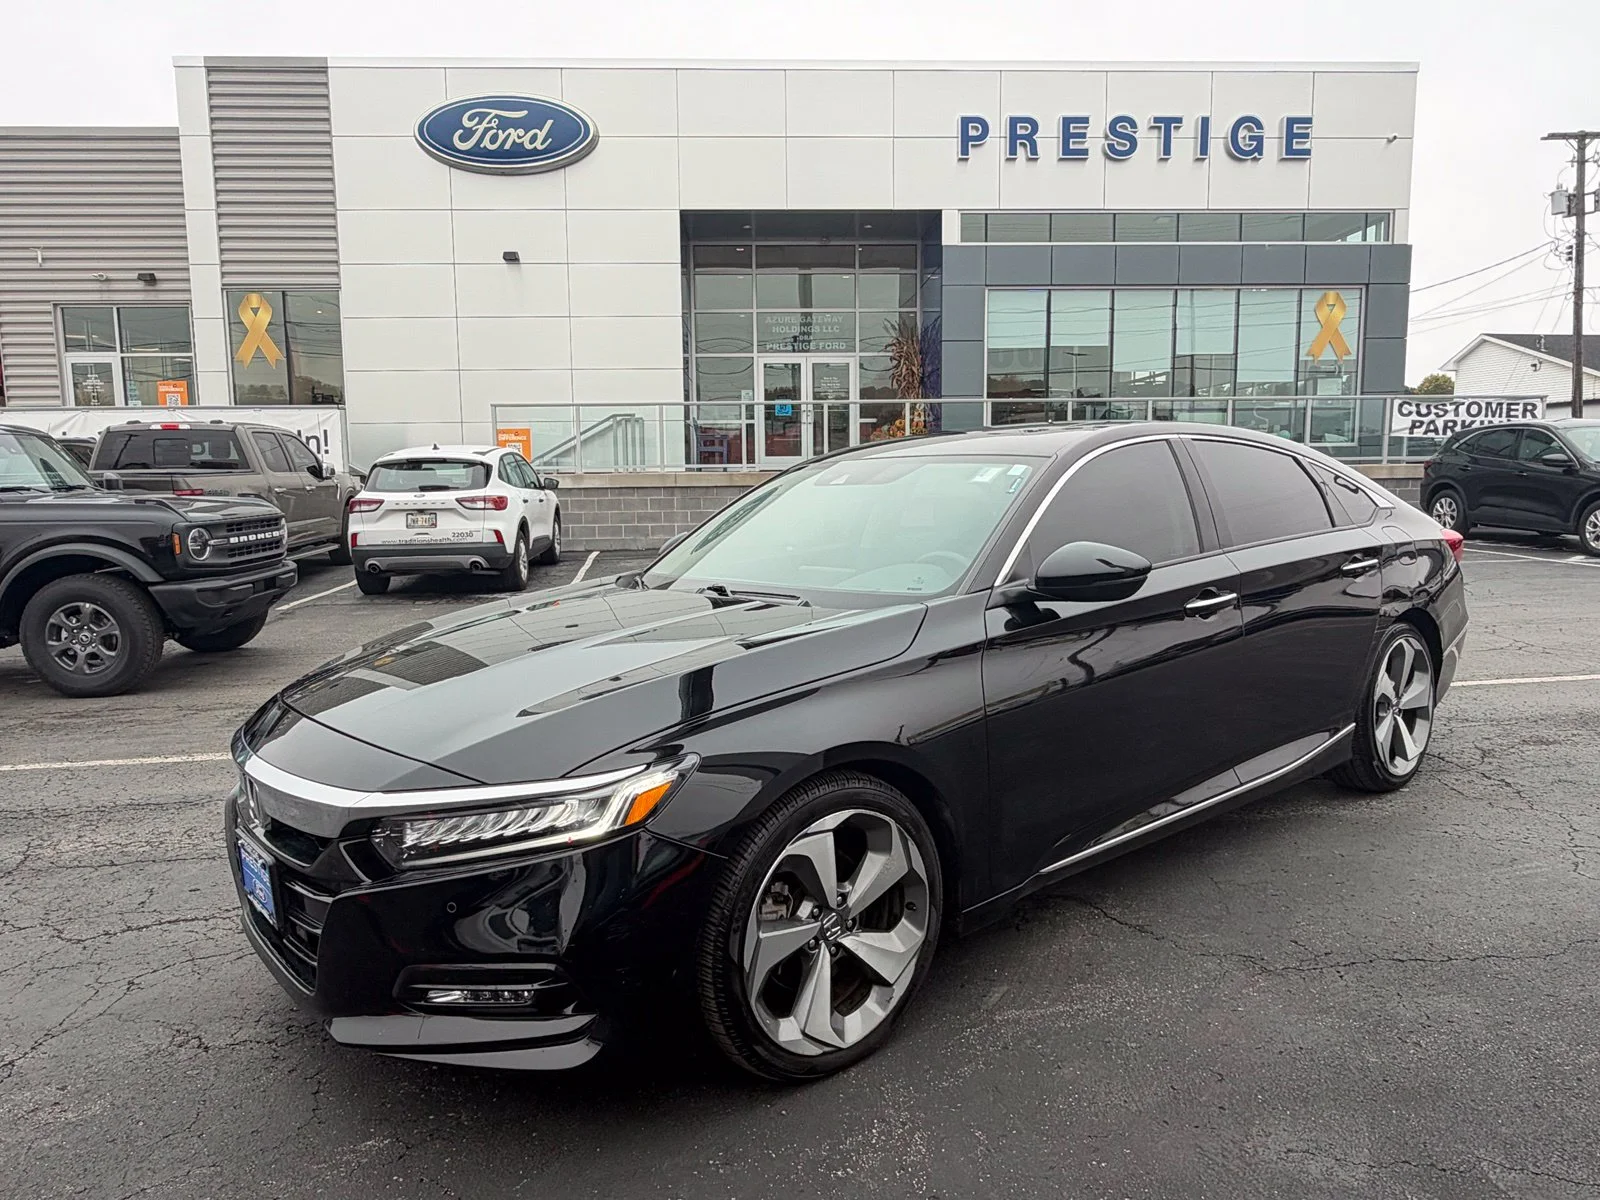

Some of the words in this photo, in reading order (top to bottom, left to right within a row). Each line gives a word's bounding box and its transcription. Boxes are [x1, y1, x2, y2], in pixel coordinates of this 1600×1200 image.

[453, 108, 553, 150] Ford
[957, 114, 1313, 161] PRESTIGE
[765, 315, 797, 324] AZURE
[799, 315, 843, 323] GATEWAY
[772, 325, 820, 333] HOLDINGS
[823, 325, 840, 333] LLC
[766, 343, 816, 351] PRESTIGE
[820, 342, 846, 350] FORD
[1398, 401, 1538, 419] CUSTOMER
[229, 530, 280, 543] BRONCO
